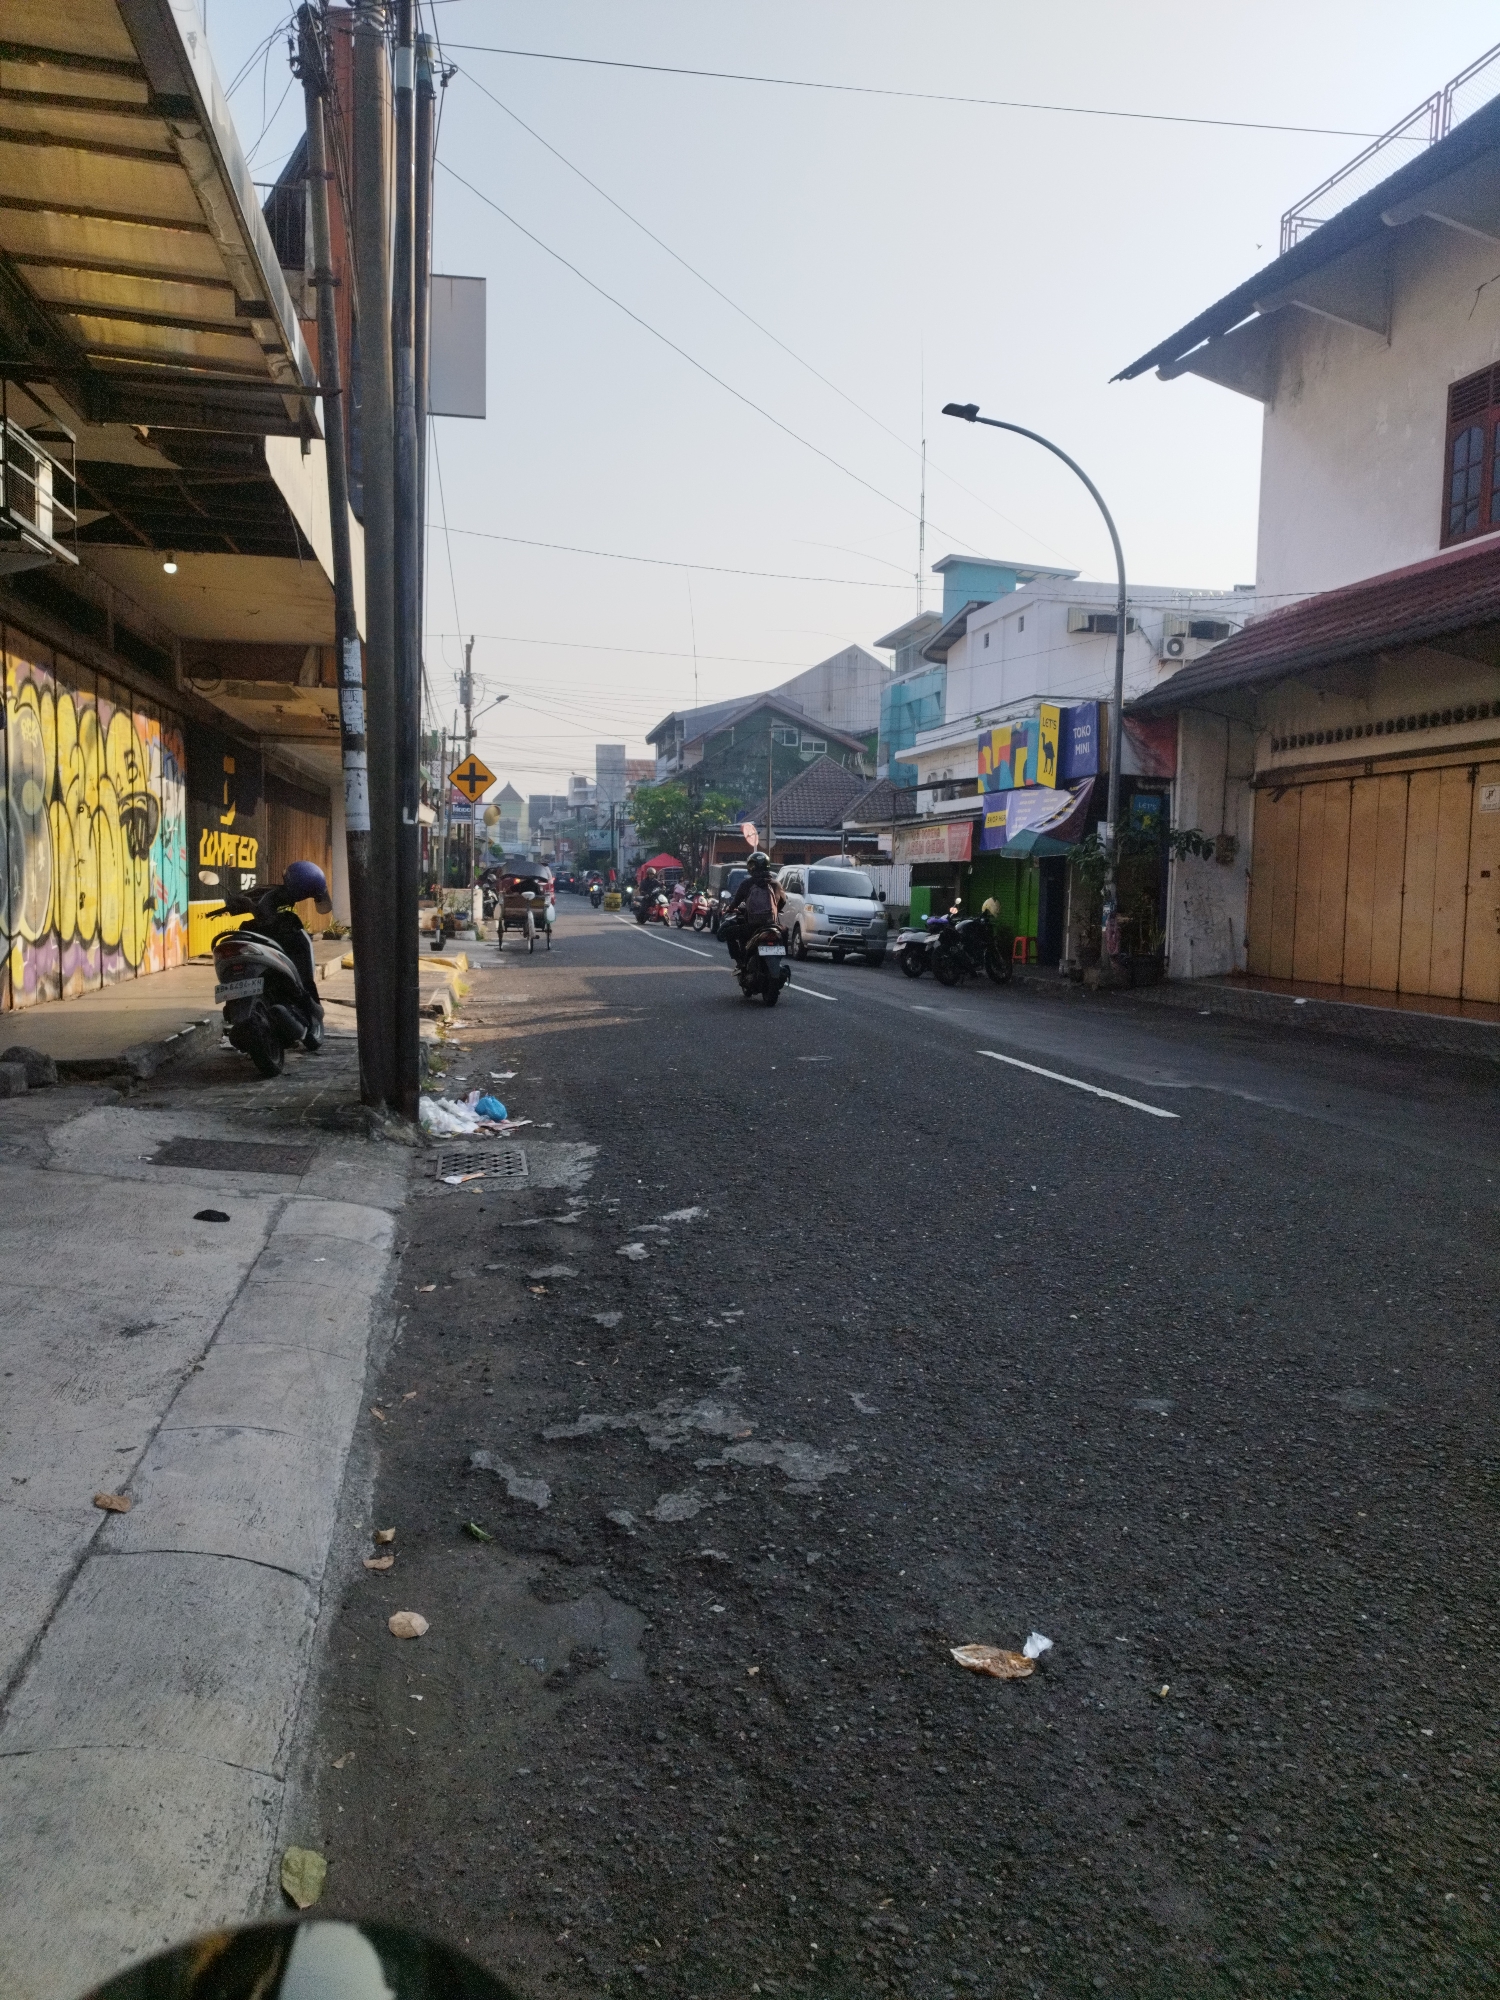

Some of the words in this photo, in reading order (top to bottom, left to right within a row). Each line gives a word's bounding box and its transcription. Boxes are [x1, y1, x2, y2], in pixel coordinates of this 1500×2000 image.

[1042, 718, 1057, 730] LET'S
[1073, 724, 1091, 739] TOKO
[1075, 742, 1090, 755] MINI
